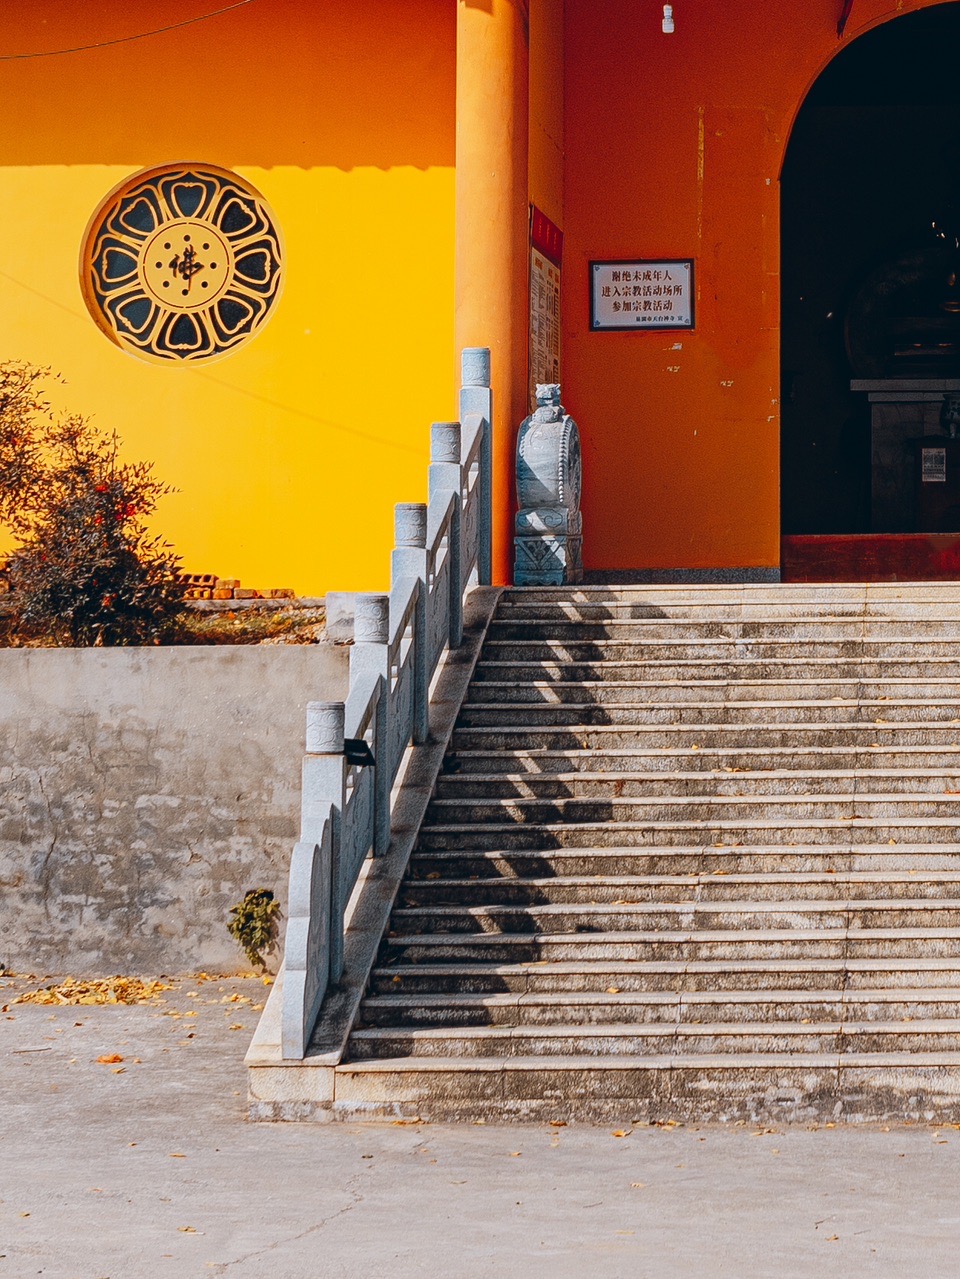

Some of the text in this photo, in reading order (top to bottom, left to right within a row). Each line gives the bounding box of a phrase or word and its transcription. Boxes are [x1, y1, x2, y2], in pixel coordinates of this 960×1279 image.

[611, 270, 672, 282] 谢绝未成年人
[601, 284, 683, 298] 进入宗教活动场所
[612, 300, 673, 312] 参加宗教活动
